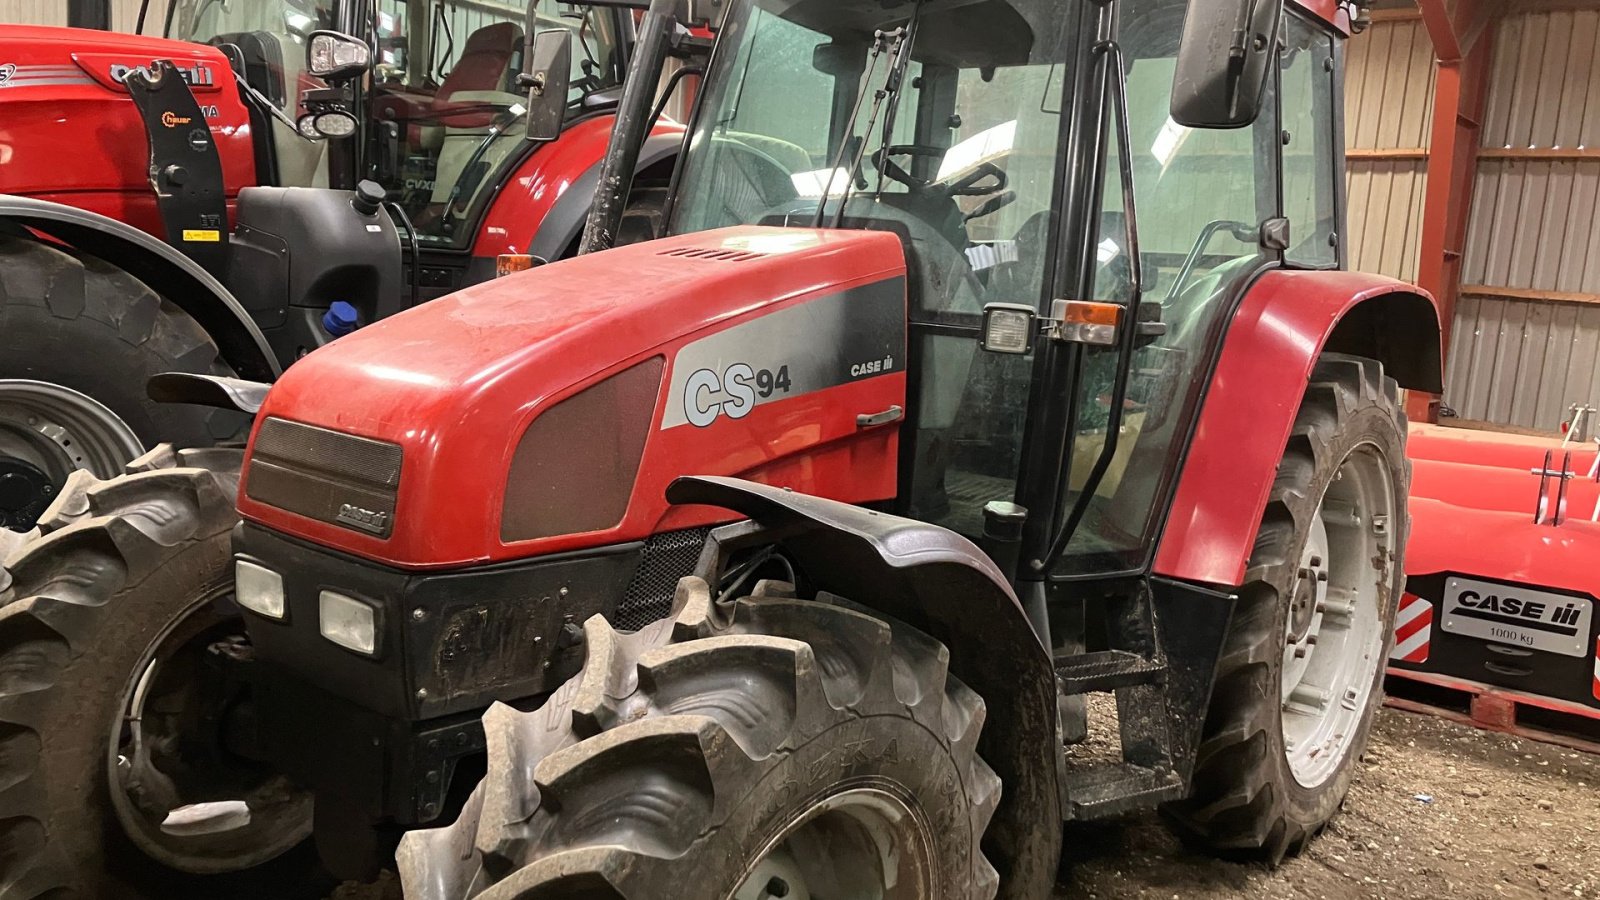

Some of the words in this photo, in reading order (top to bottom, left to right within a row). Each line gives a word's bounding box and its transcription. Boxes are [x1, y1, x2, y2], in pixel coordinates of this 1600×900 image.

[851, 362, 880, 376] CASE
[1457, 590, 1546, 619] CASE
[1490, 627, 1517, 640] 1000
[1520, 633, 1534, 646] kg
